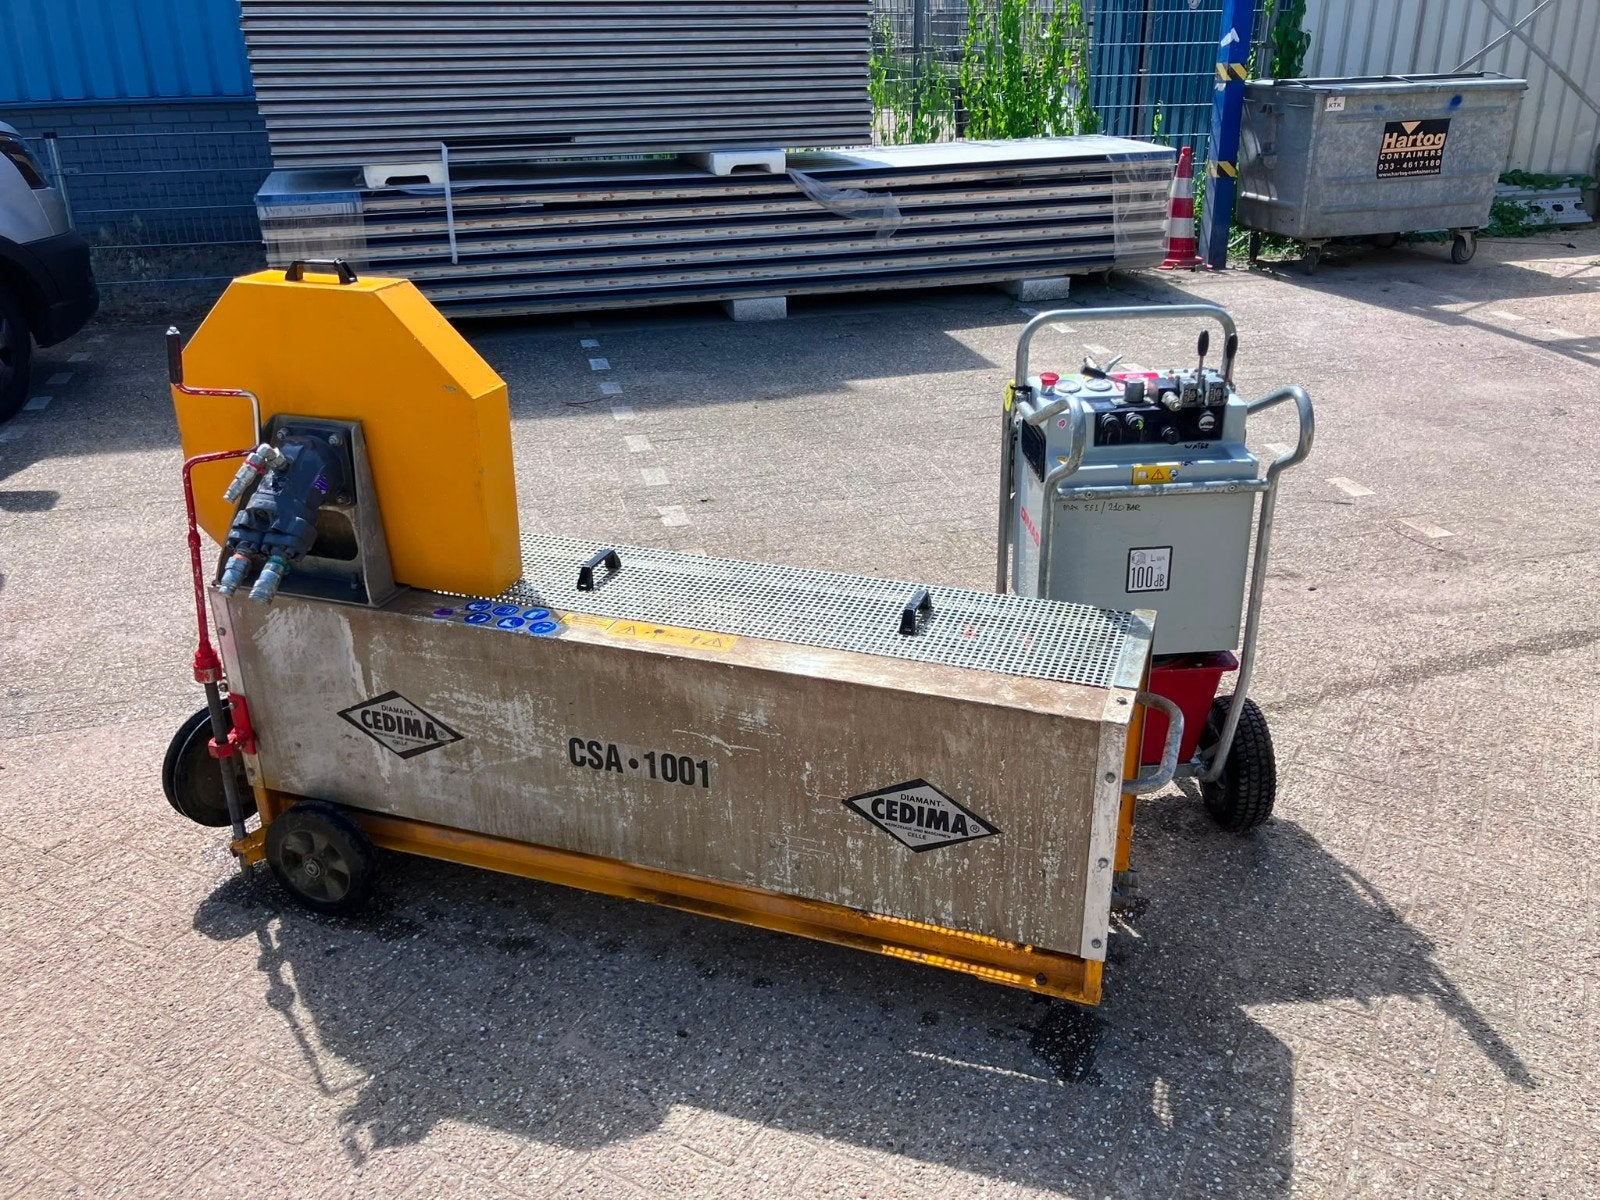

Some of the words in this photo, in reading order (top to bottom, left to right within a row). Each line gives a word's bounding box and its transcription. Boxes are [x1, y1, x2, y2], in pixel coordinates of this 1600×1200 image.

[1382, 131, 1446, 150] Hartog
[1380, 150, 1442, 160] CONTAINERS
[1378, 162, 1395, 171] 033
[1402, 159, 1440, 169] 4617180
[1131, 565, 1154, 589] 100
[1153, 573, 1165, 587] dB
[360, 709, 439, 741] CEDIMA
[900, 793, 945, 807] DIAMANT-
[870, 797, 969, 836] CEDIMA
[907, 832, 927, 840] CELLE
